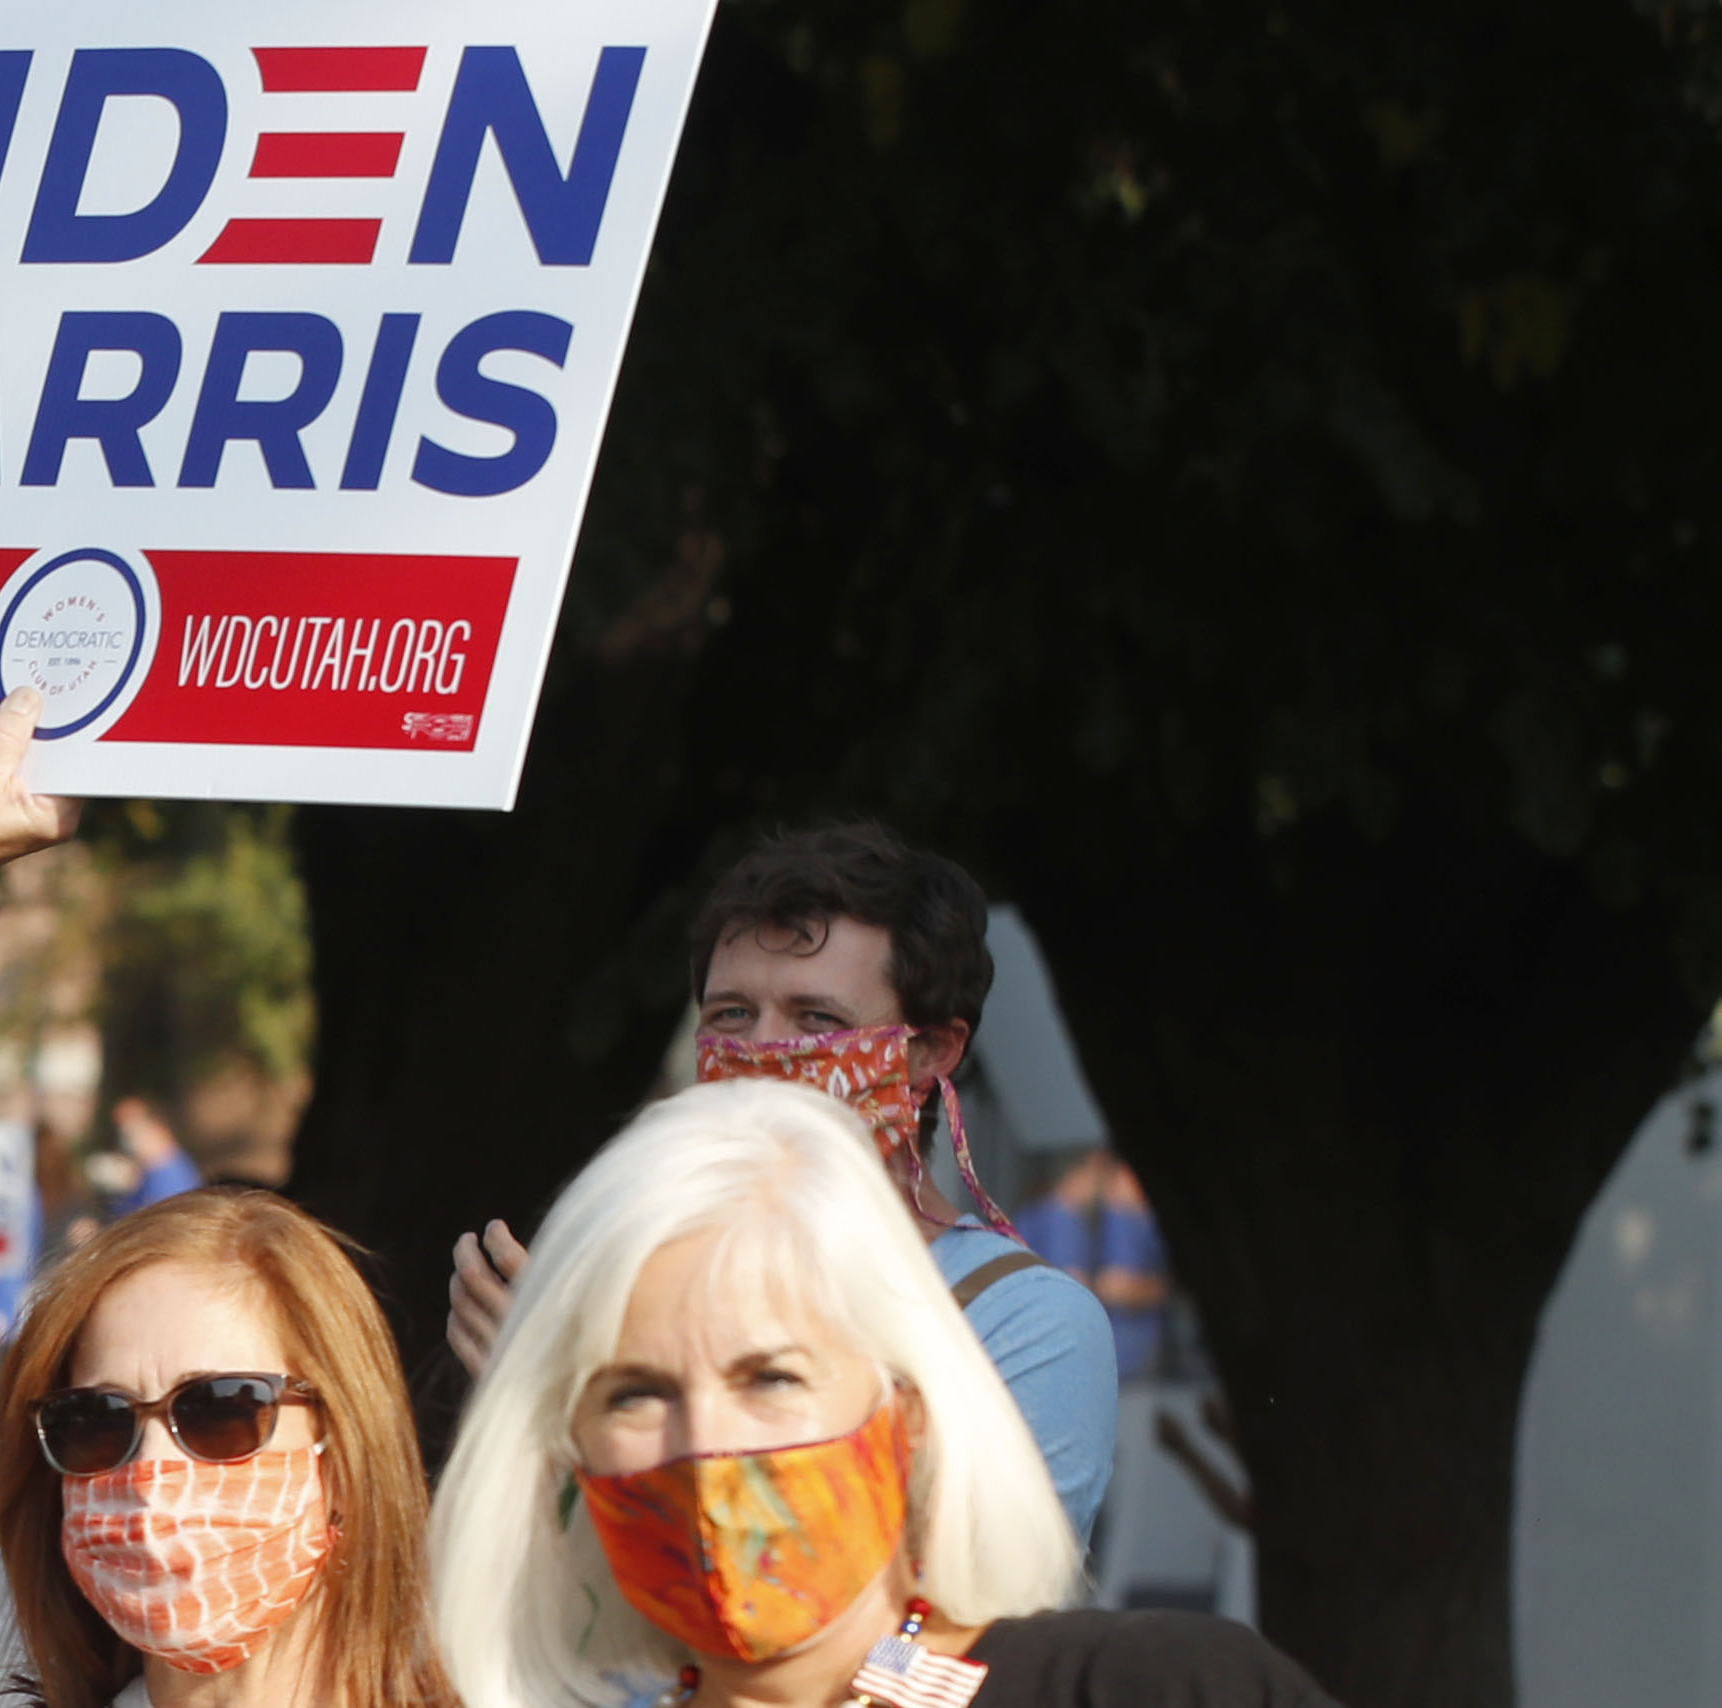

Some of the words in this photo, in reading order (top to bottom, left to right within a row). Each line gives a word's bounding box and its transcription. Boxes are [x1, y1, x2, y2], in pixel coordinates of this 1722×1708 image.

[42, 595, 106, 622] WOMEN'S
[14, 628, 124, 650] DEMOCRATIC
[175, 610, 472, 697] WDCUTAH.ORG
[28, 659, 48, 692] CLUB
[49, 685, 65, 696] OF
[68, 659, 99, 692] UTAH
